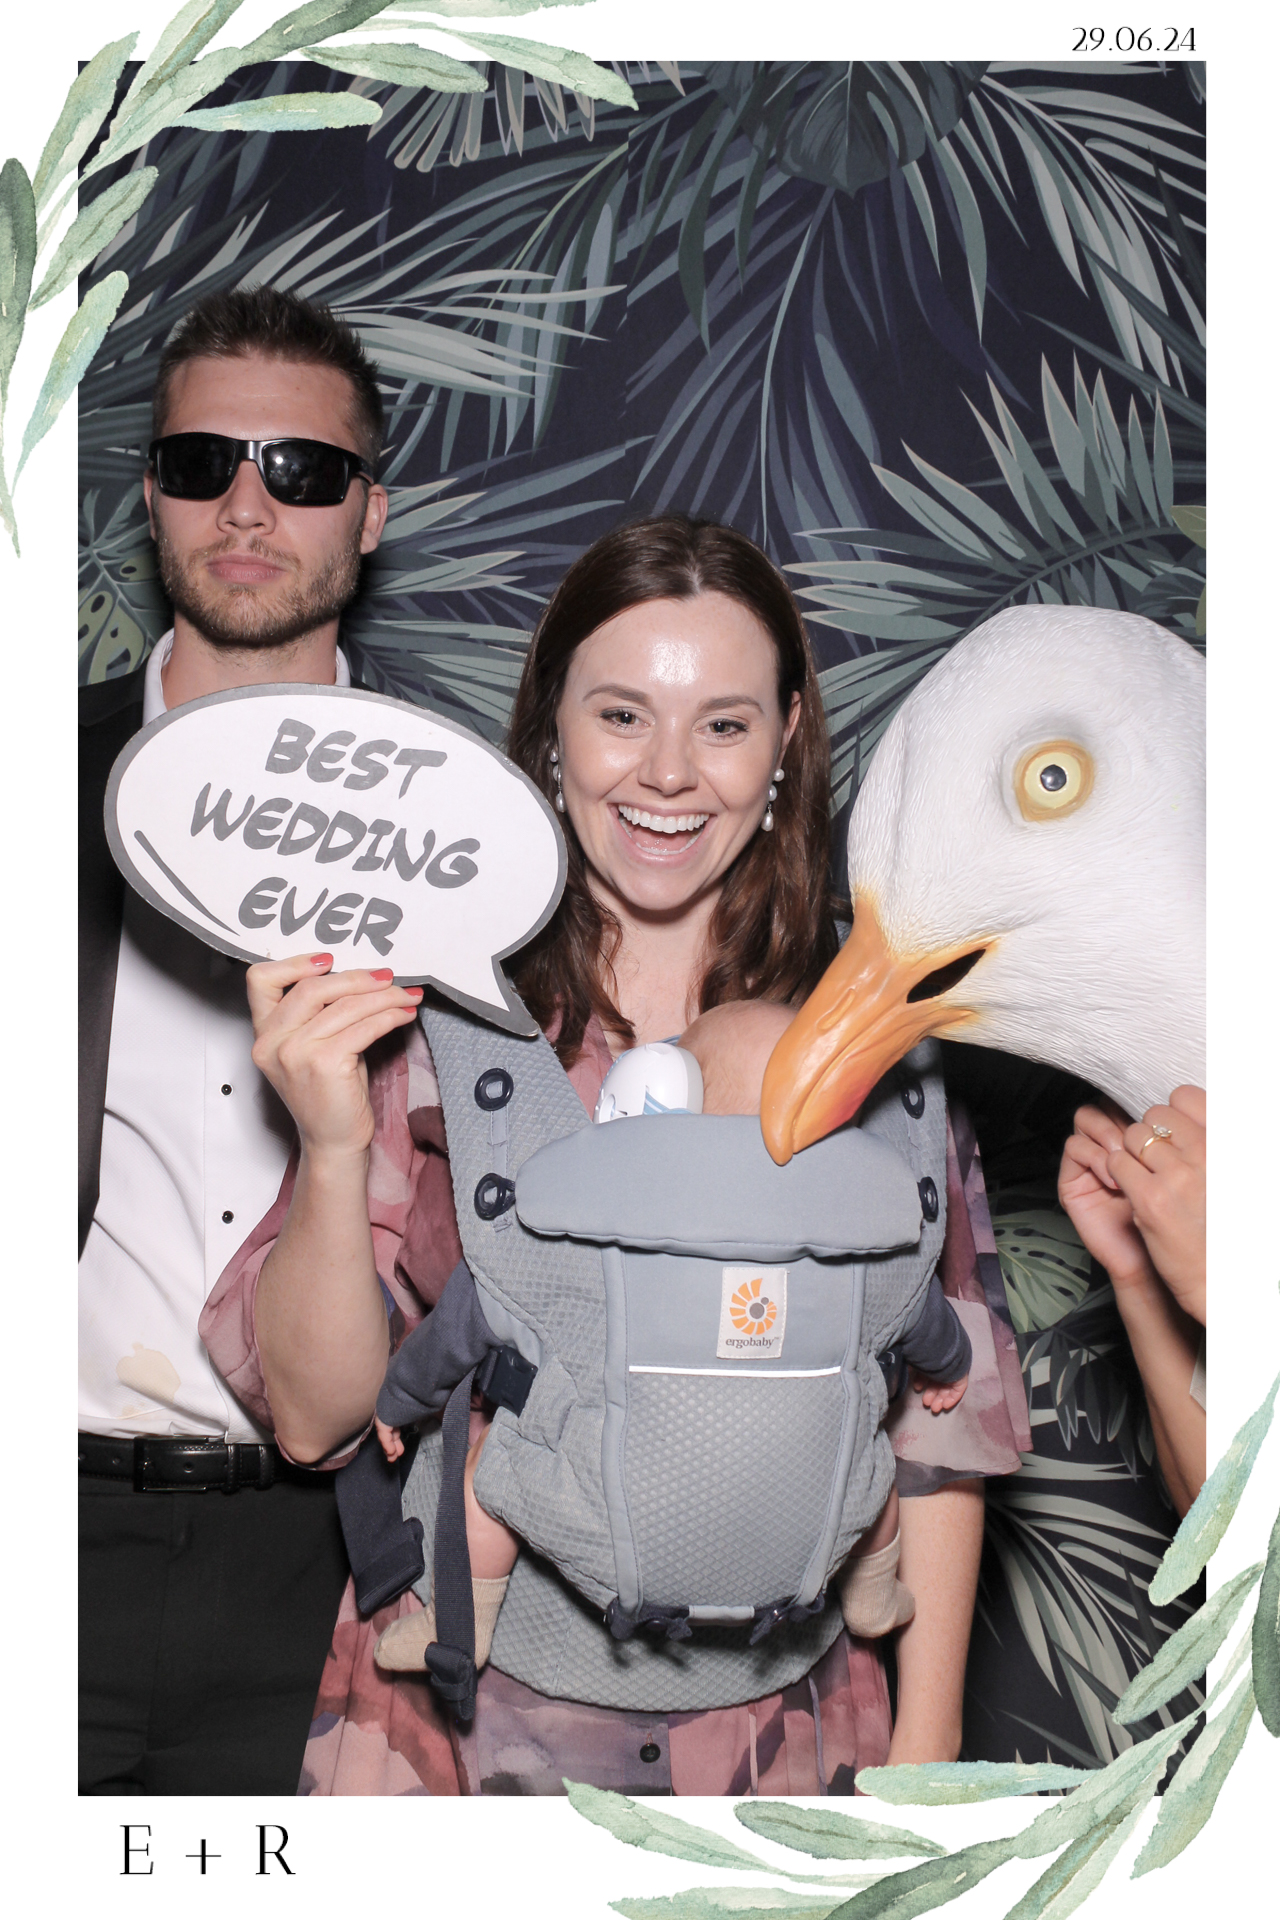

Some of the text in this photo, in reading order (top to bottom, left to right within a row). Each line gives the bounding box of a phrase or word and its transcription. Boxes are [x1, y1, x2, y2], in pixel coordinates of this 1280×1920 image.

[264, 717, 448, 800] BEST
[189, 782, 482, 889] WEDDING
[237, 876, 404, 957] EVER
[725, 1336, 775, 1349] ergobaby
